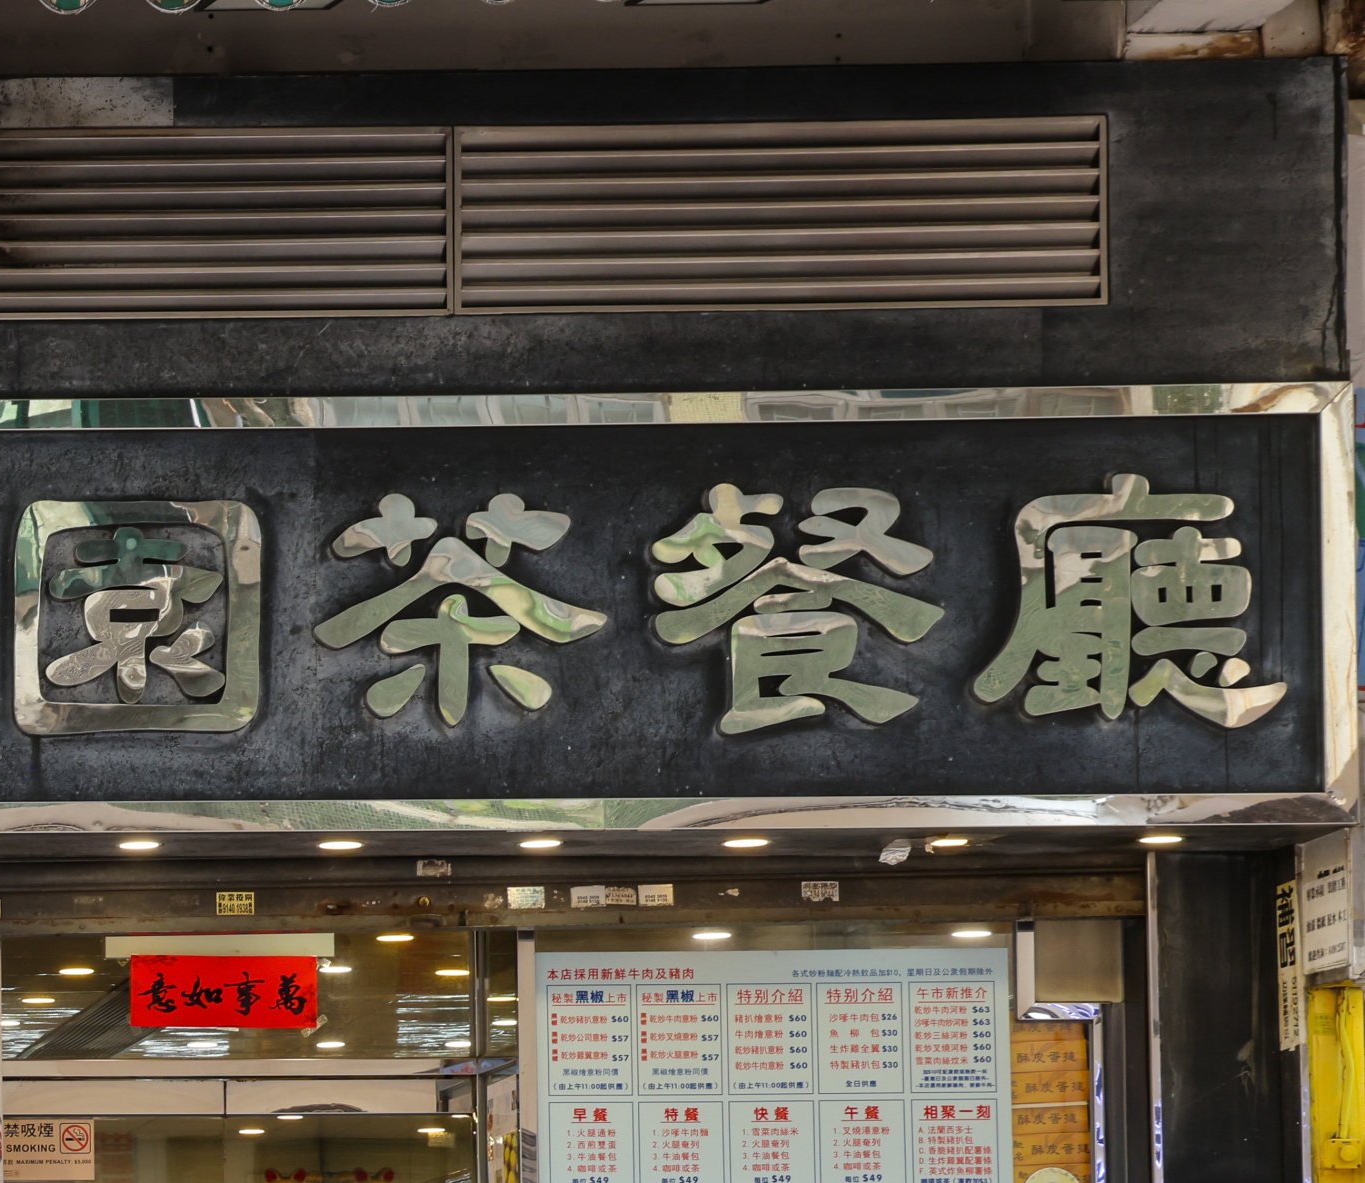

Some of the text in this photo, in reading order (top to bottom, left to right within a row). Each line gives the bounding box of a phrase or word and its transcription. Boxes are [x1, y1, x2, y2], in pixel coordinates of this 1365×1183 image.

[1277, 885, 1296, 968] 補習
[547, 968, 695, 980] 本店採用新鮮牛肉及豬肉
[140, 972, 307, 1016] 萬事如意
[552, 990, 627, 1004] 秘製黑椒上市
[641, 990, 717, 1003] 秘製黑椒上市
[917, 987, 987, 1000] 午市新推介
[972, 1005, 991, 1013] $63
[611, 1015, 629, 1023] $60
[701, 1014, 719, 1022] $60
[881, 1013, 897, 1021] $26
[611, 1034, 629, 1043] $57
[882, 1061, 898, 1069] $30
[573, 1107, 608, 1122] 早餐
[664, 1107, 699, 1121] 特餐
[754, 1106, 790, 1121] 快餐
[844, 1105, 880, 1120] 午餐
[923, 1104, 991, 1119] 相聚一刻
[4, 1122, 54, 1138] 禁吸煙
[6, 1144, 56, 1152] SMOKING
[679, 1176, 698, 1183] $49
